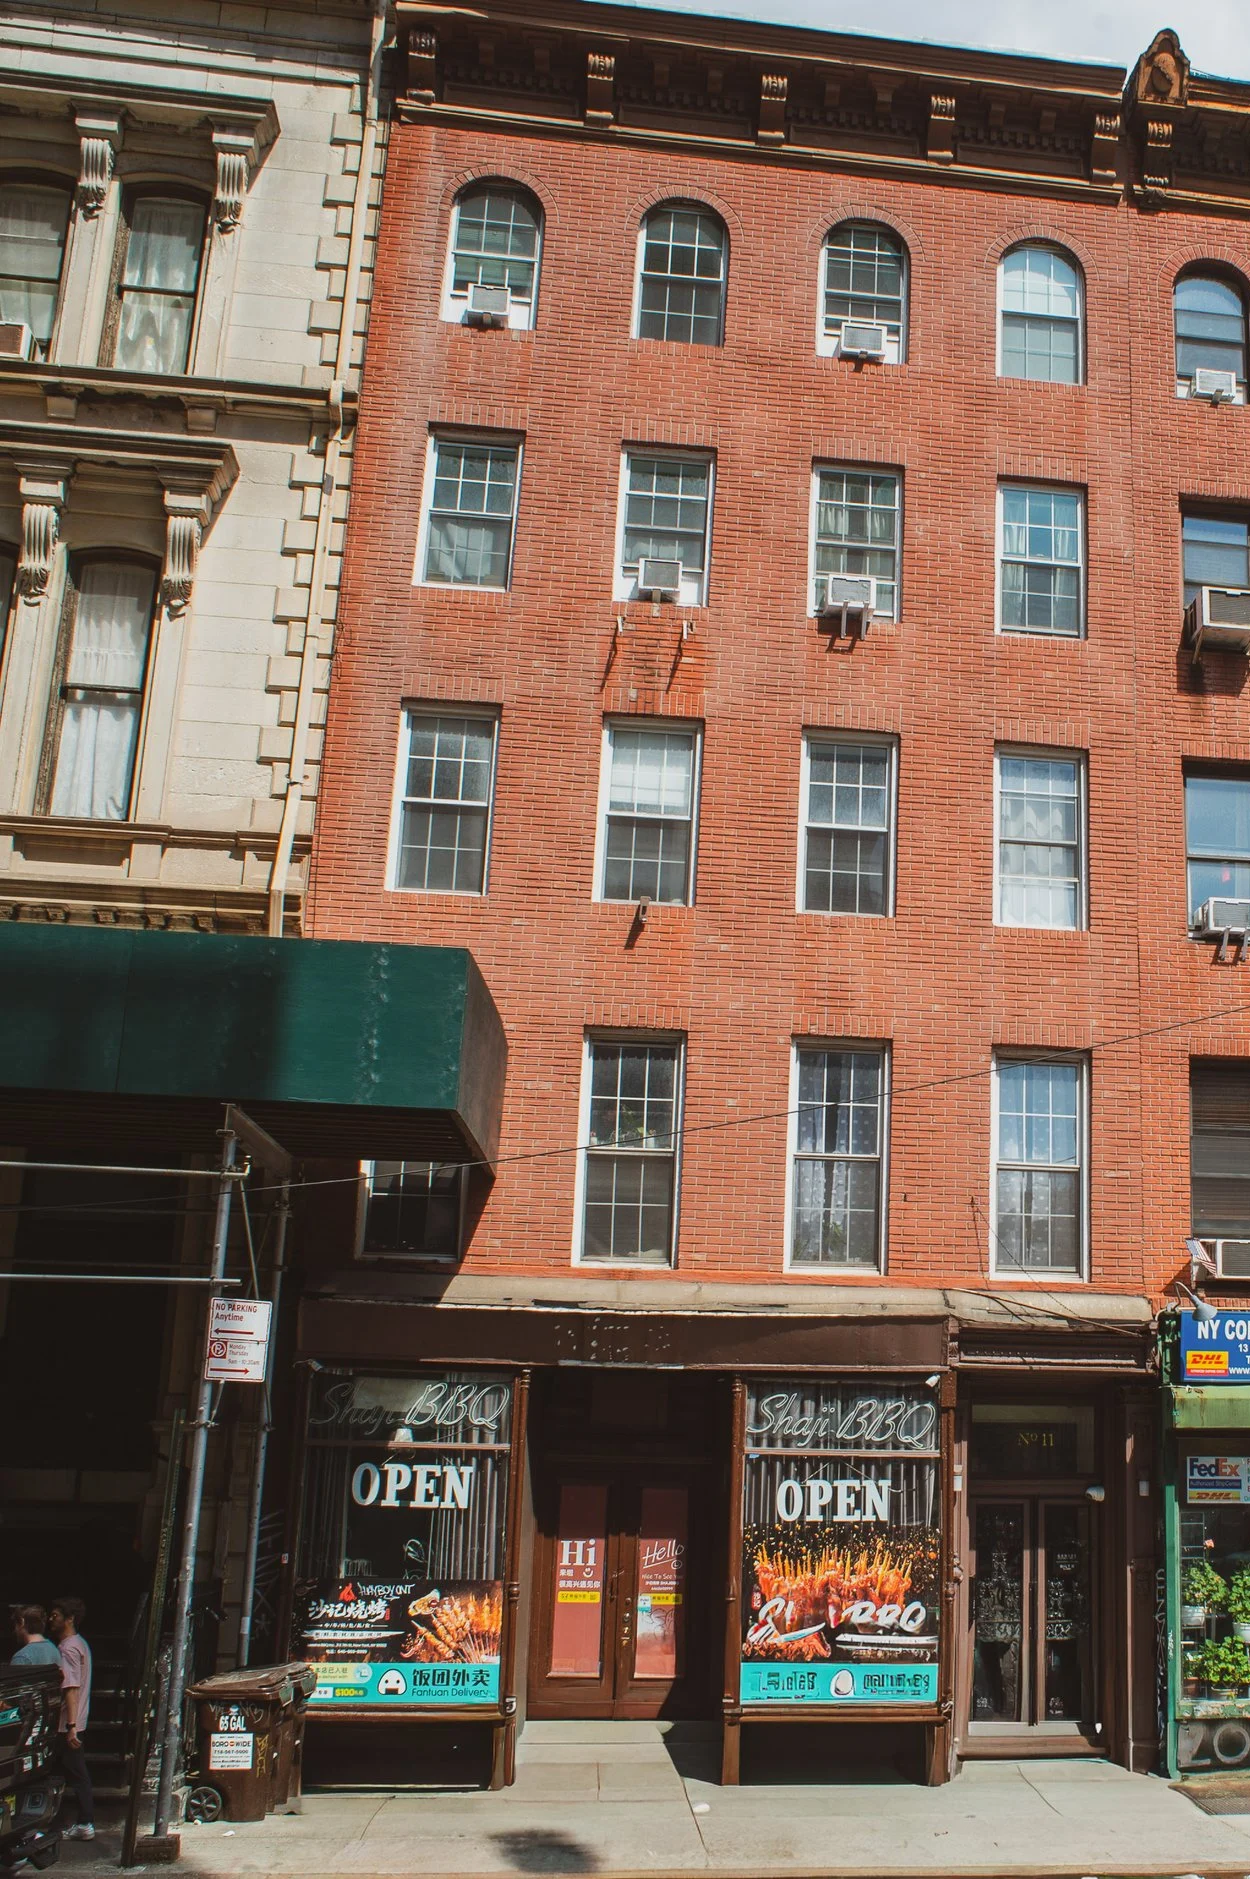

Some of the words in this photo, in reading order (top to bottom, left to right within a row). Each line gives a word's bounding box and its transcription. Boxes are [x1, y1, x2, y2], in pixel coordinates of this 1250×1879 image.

[214, 1313, 244, 1321] Anytime
[215, 1303, 226, 1311] NO
[227, 1304, 258, 1313] PARKING
[1197, 1319, 1220, 1340] NY
[1238, 1344, 1248, 1353] 13
[1191, 1354, 1225, 1365] DHL
[404, 1382, 511, 1430] BBQ
[745, 1392, 836, 1447] Shaji
[835, 1399, 937, 1449] BBQ
[1041, 1431, 1055, 1447] 11
[1189, 1457, 1240, 1477] FedEx
[352, 1462, 474, 1509] OPEN
[776, 1479, 892, 1522] OPEN
[1196, 1492, 1233, 1500] DHL
[560, 1538, 597, 1566] Hi
[641, 1539, 685, 1566] Hello
[308, 1598, 389, 1622] 沙记烧烤
[411, 1668, 491, 1687] 饭团外卖
[411, 1688, 449, 1697] Fantuan
[451, 1688, 490, 1698] Delivery
[219, 1715, 229, 1731] 65
[229, 1715, 247, 1731] GAL
